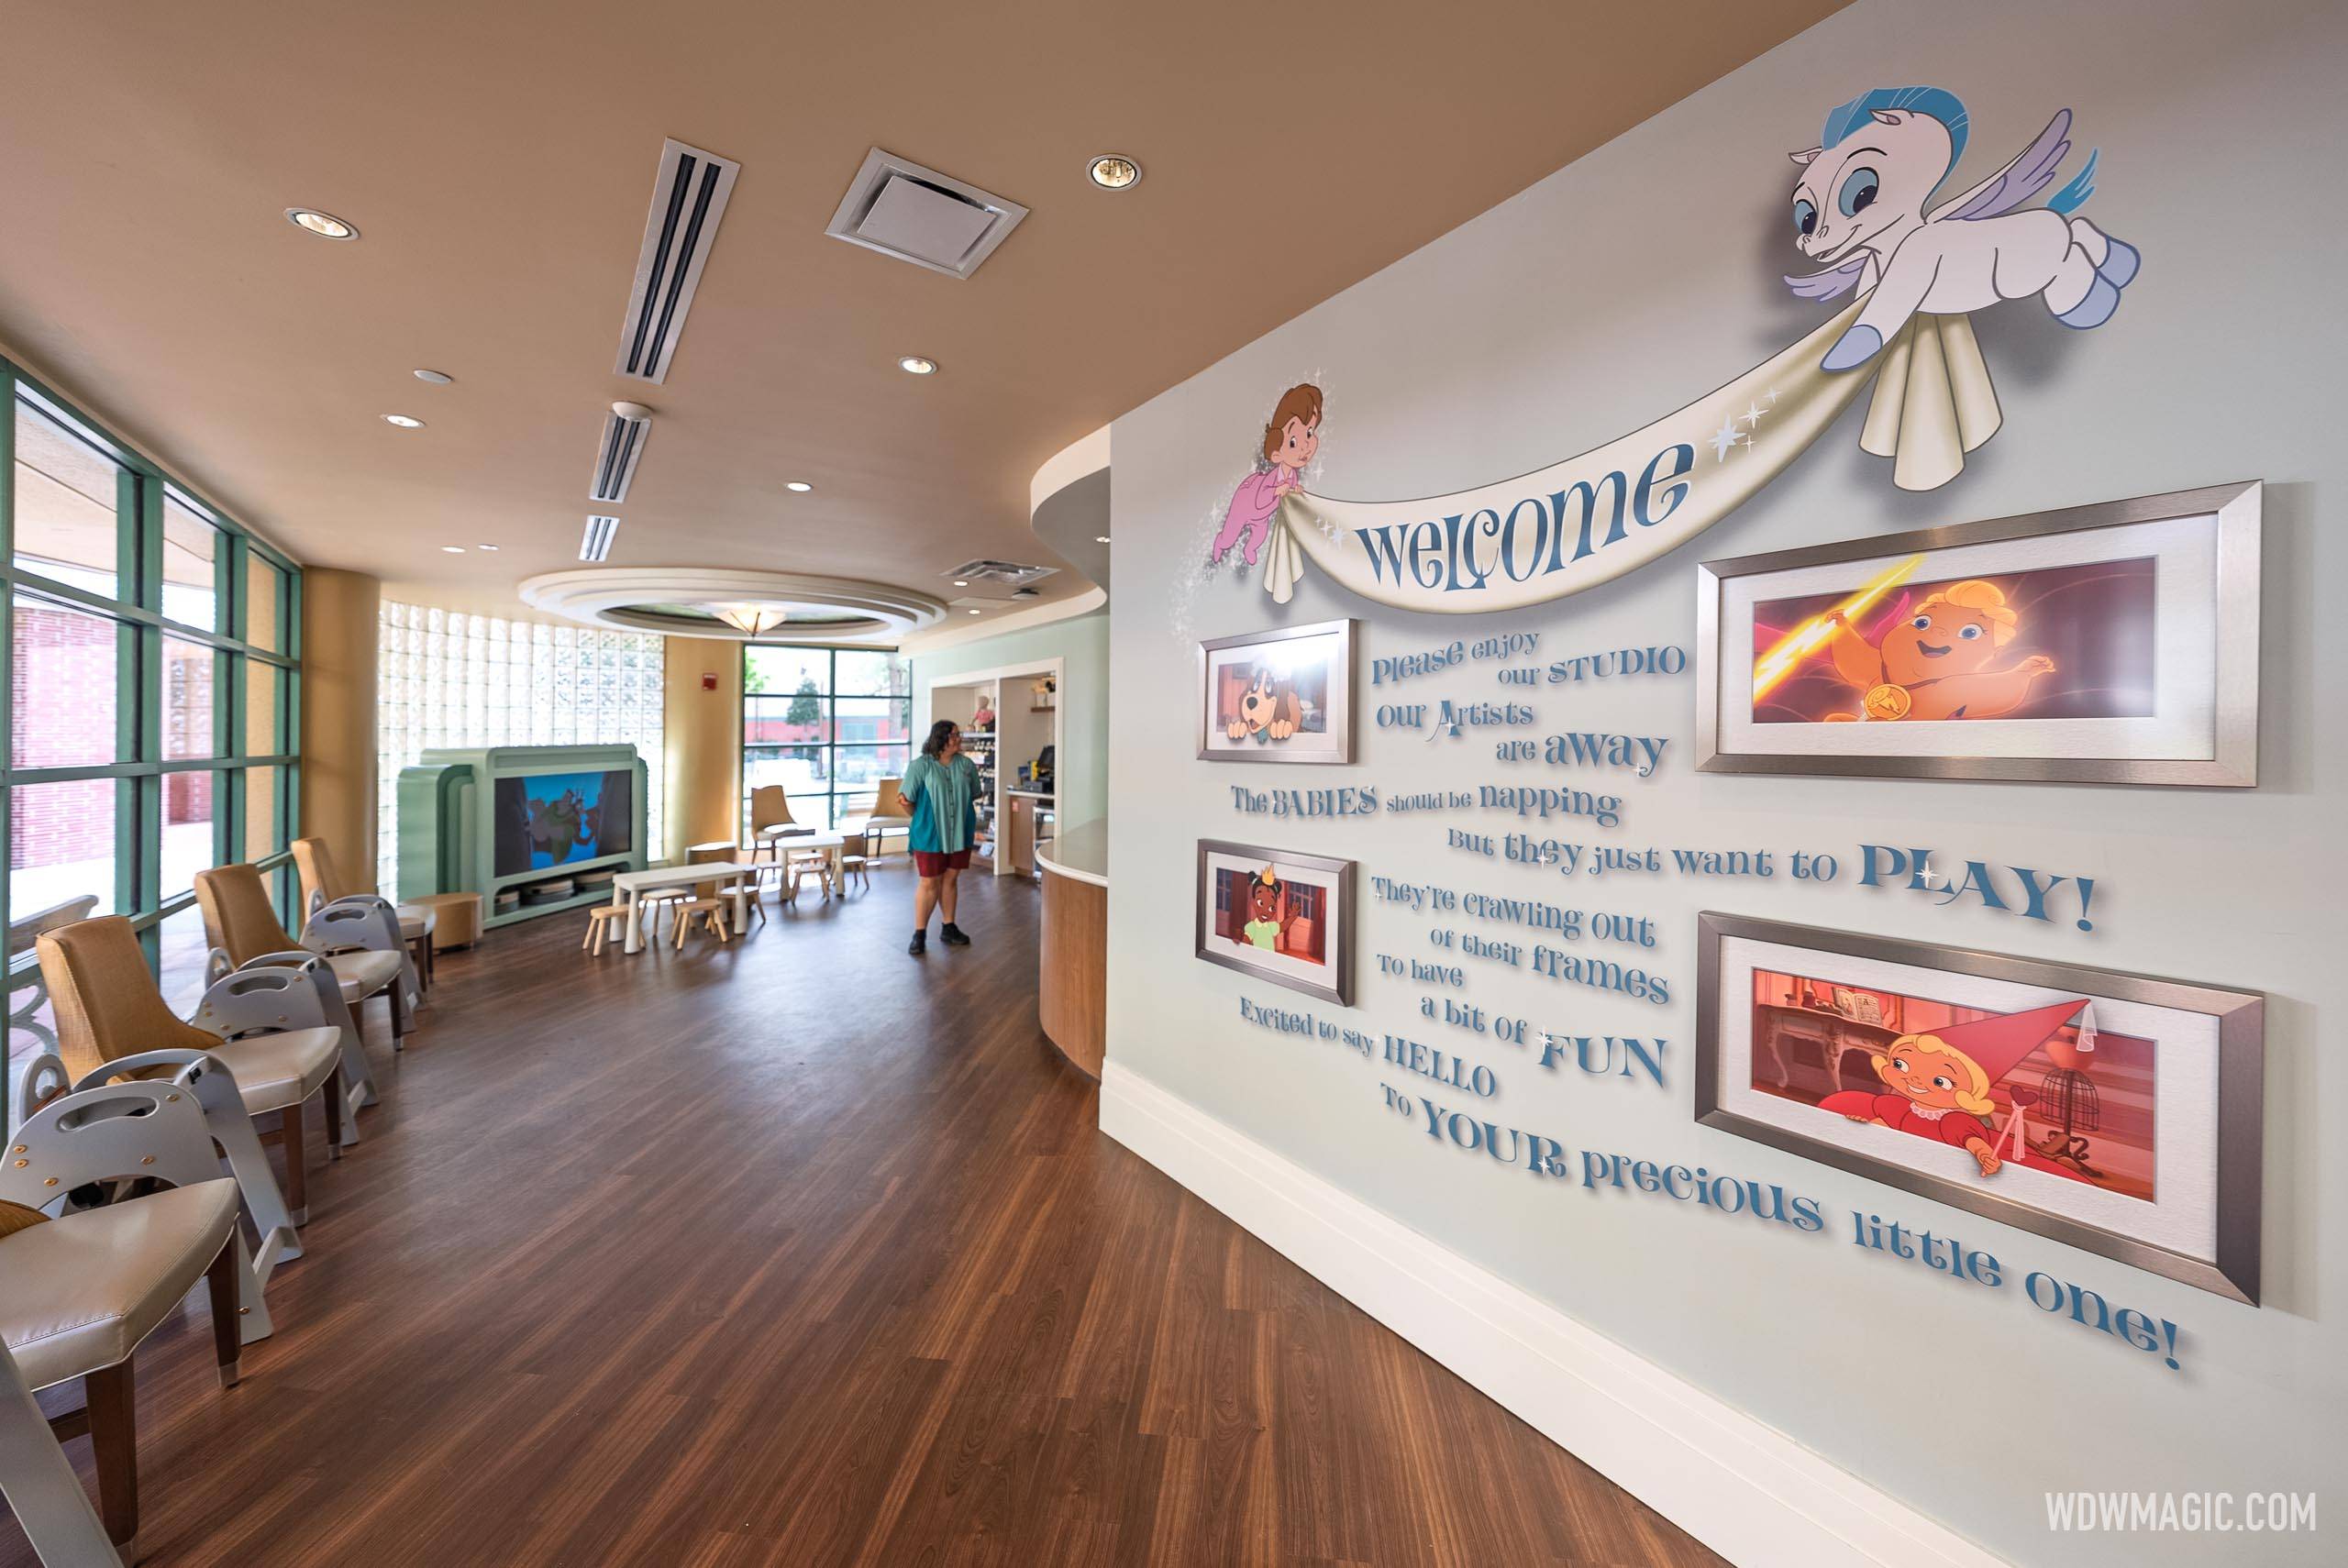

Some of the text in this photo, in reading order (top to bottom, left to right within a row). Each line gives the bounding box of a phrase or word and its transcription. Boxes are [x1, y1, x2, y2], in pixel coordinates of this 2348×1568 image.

[1471, 632, 1540, 661] enjoy
[1547, 645, 1687, 683] STUDIO
[1426, 700, 1534, 742] Artists
[1496, 732, 1669, 778] are away
[1230, 785, 1622, 827] The BABIES should be napping
[1447, 828, 2095, 932] But they just want to PLAY!
[1463, 890, 1583, 940] crawling
[1591, 912, 1657, 947] out
[1411, 958, 1464, 988] have
[1430, 928, 1669, 1005] of their frames
[1239, 996, 1497, 1098] Excited to say HELLO
[1421, 996, 1669, 1088] a bit of FUN
[1418, 1098, 1567, 1178] YOUR
[1579, 1148, 1825, 1231] precious
[1851, 1210, 2003, 1288] little
[2024, 1271, 2180, 1371] one!
